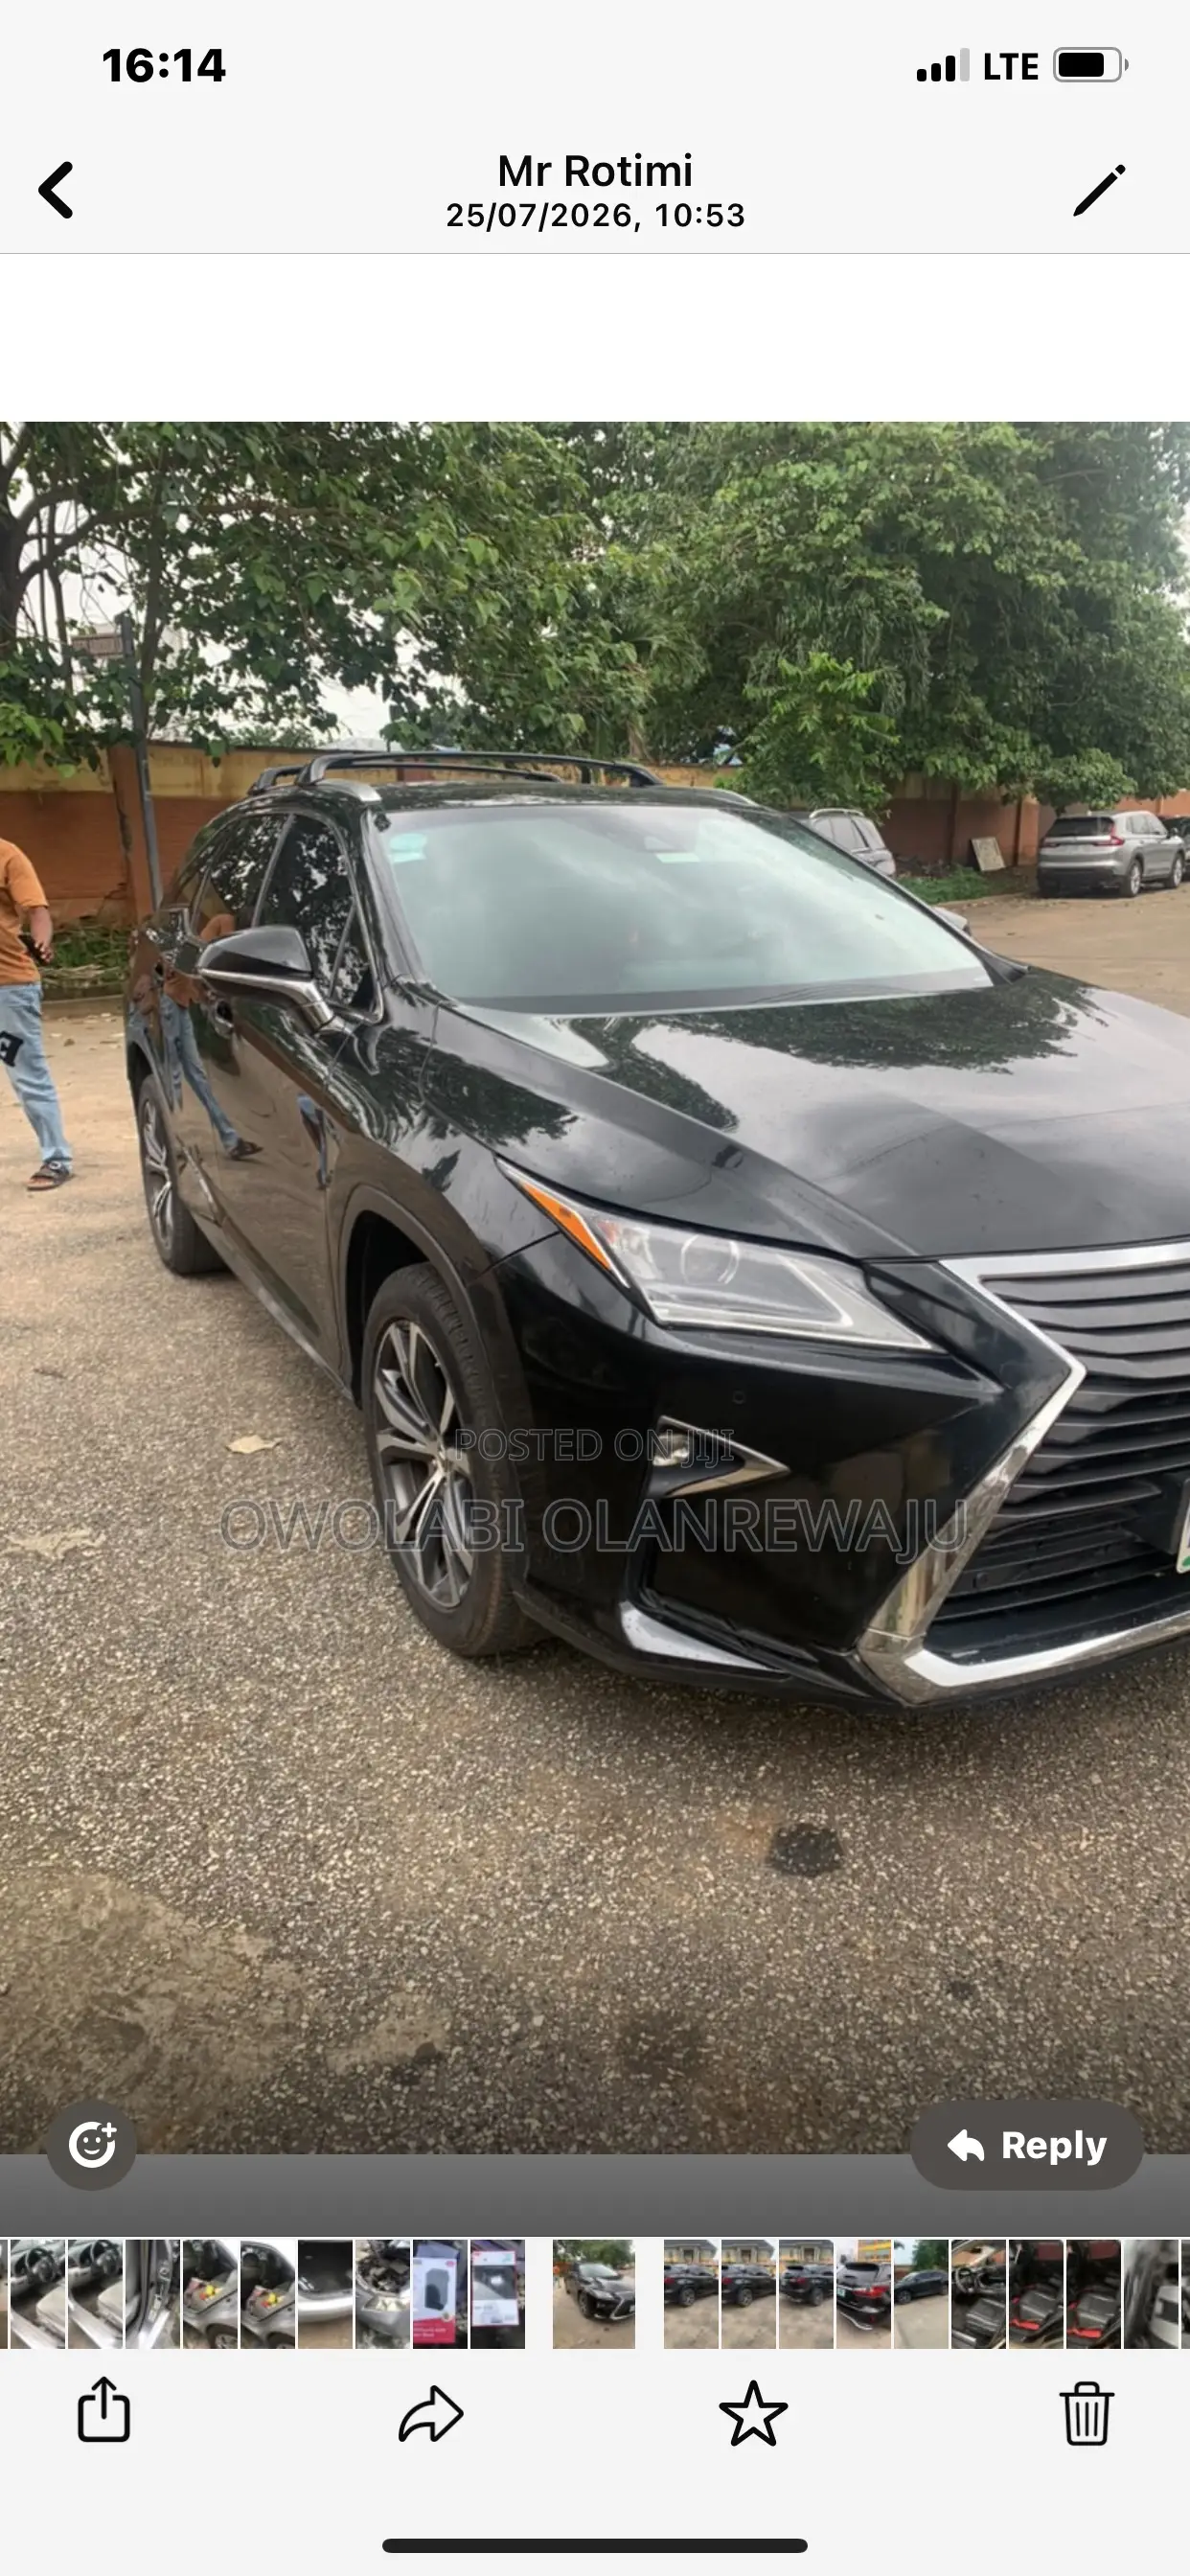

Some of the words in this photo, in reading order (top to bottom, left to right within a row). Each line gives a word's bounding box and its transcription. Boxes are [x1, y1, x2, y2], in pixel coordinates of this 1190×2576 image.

[103, 47, 226, 83] 16:14
[984, 52, 1039, 80] LTE
[499, 154, 553, 187] Mr
[565, 152, 692, 187] Rotimi
[446, 202, 641, 233] 25/07/2026,
[655, 202, 744, 228] 10:53
[1002, 2129, 1108, 2166] Reply
